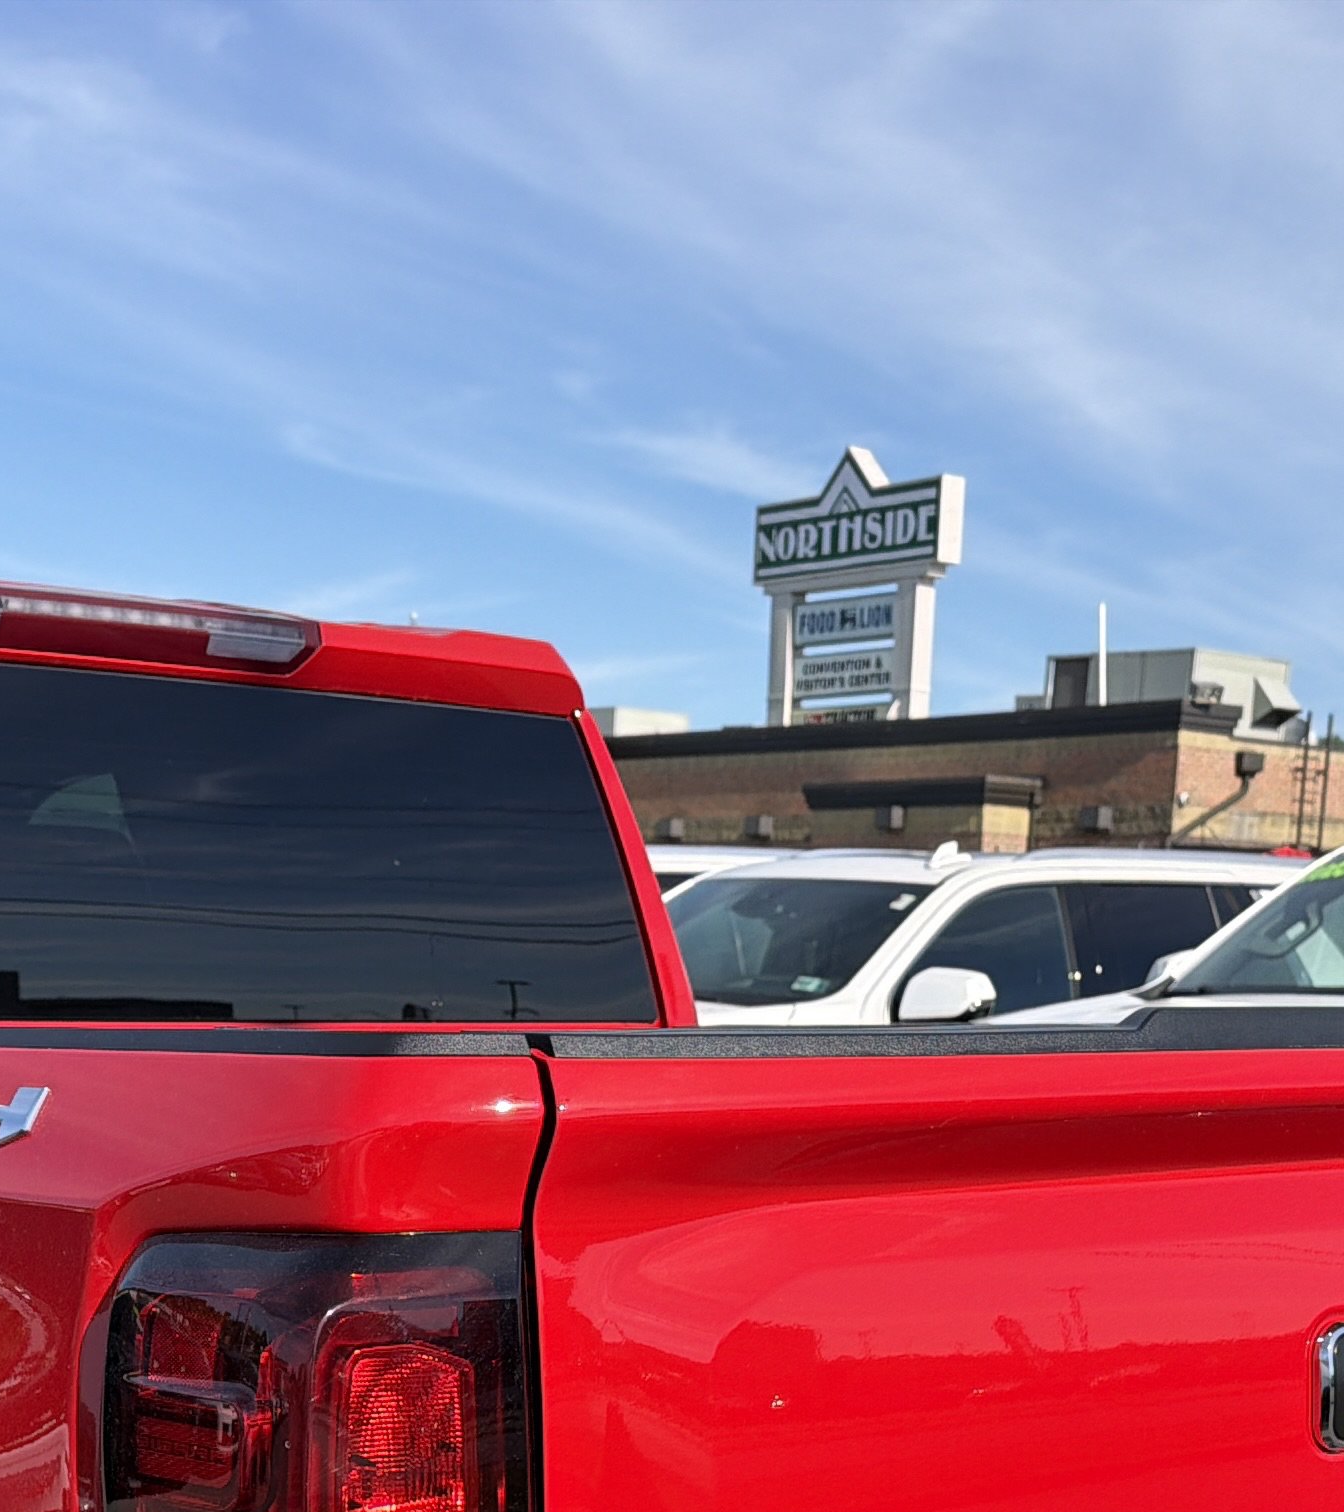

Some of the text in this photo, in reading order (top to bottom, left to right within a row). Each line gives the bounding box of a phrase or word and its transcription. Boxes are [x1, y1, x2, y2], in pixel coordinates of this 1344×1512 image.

[757, 503, 936, 563] NORTHSIDE
[798, 603, 894, 635] FOOD LION
[801, 657, 871, 676] CONVENTION
[848, 671, 891, 688] CENTER
